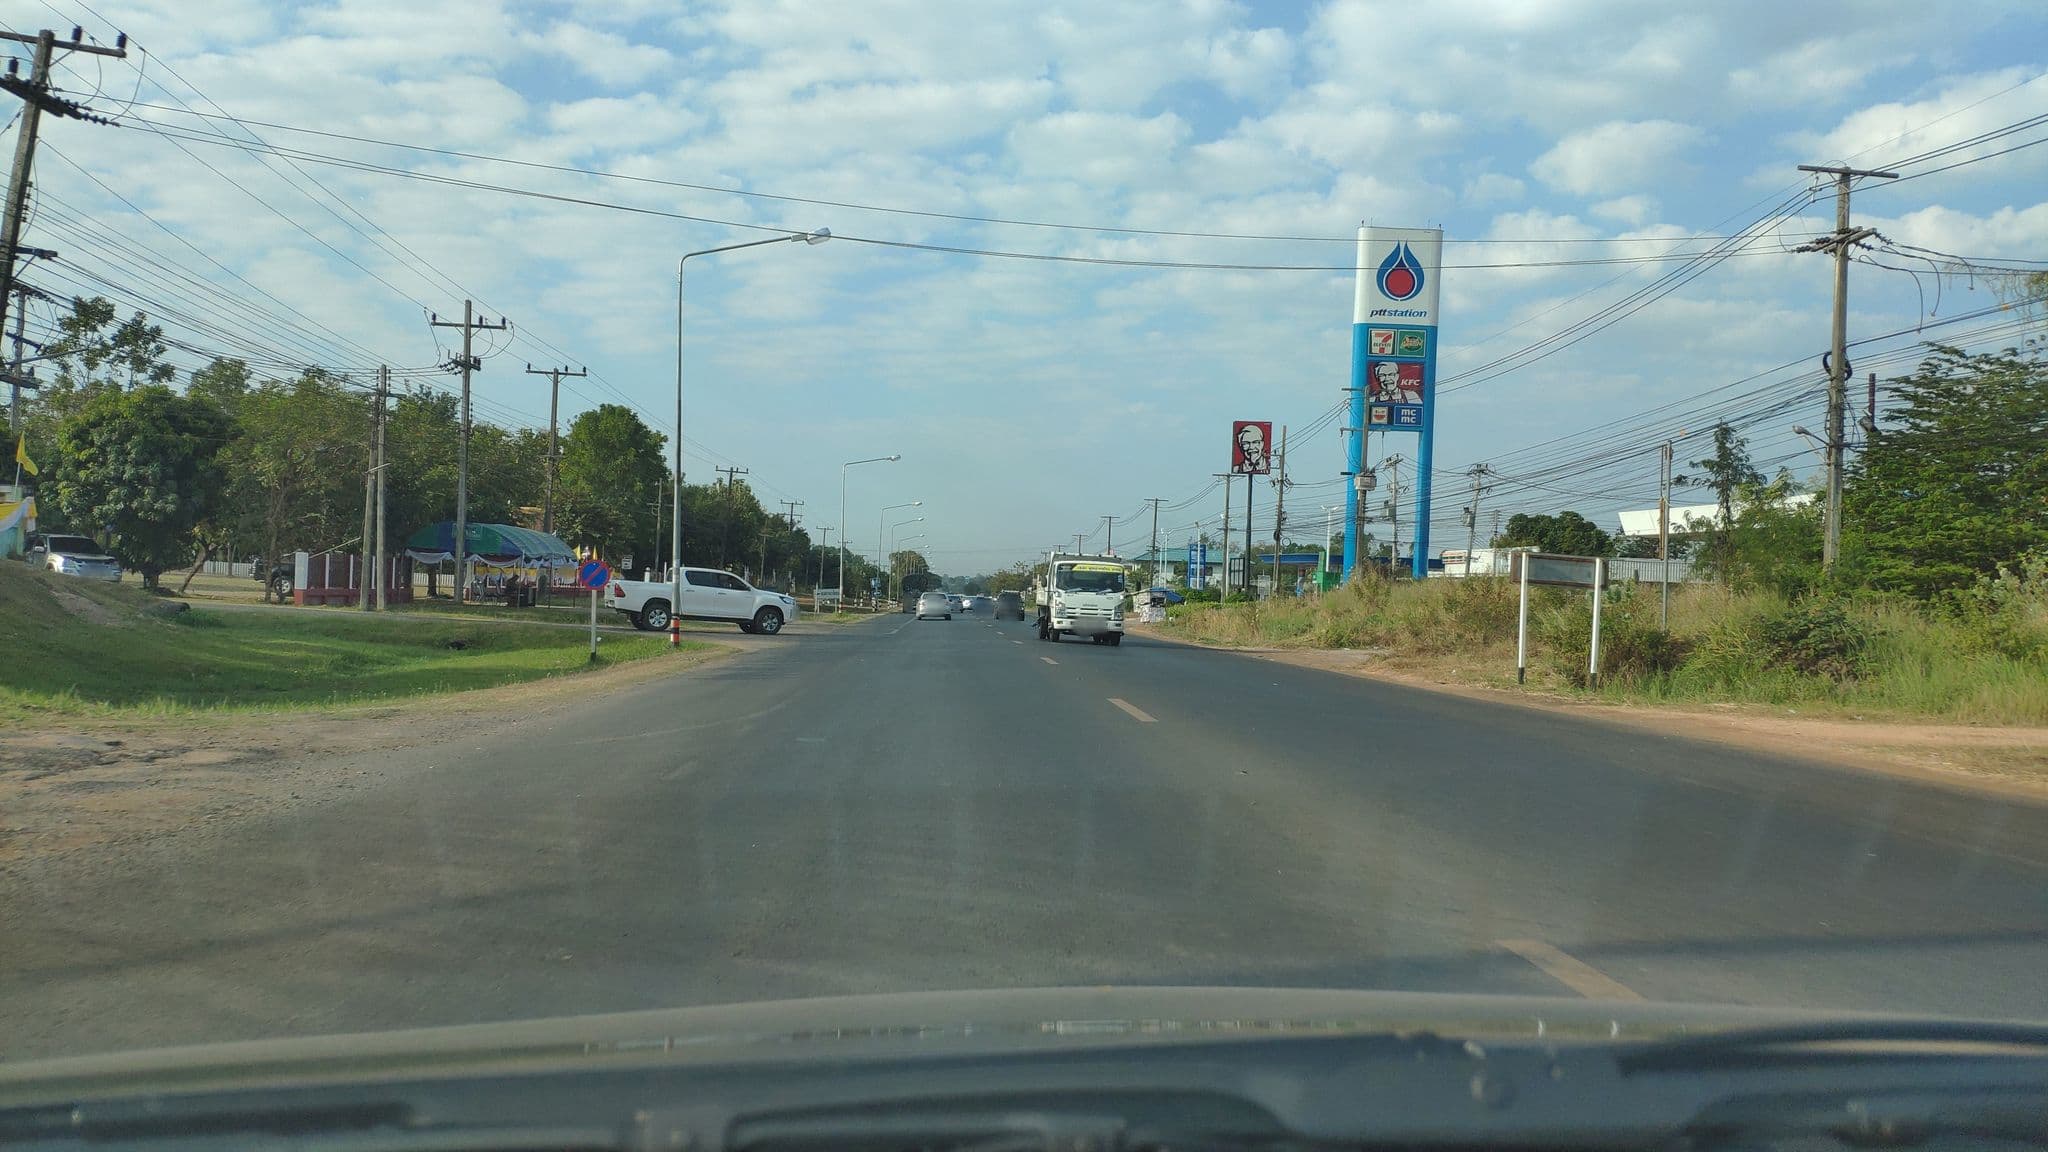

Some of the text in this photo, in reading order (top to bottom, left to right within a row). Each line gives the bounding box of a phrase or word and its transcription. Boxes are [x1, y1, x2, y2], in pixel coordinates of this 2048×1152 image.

[1400, 378, 1420, 386] KFC
[1401, 406, 1417, 416] mc
[1400, 416, 1417, 424] mc
